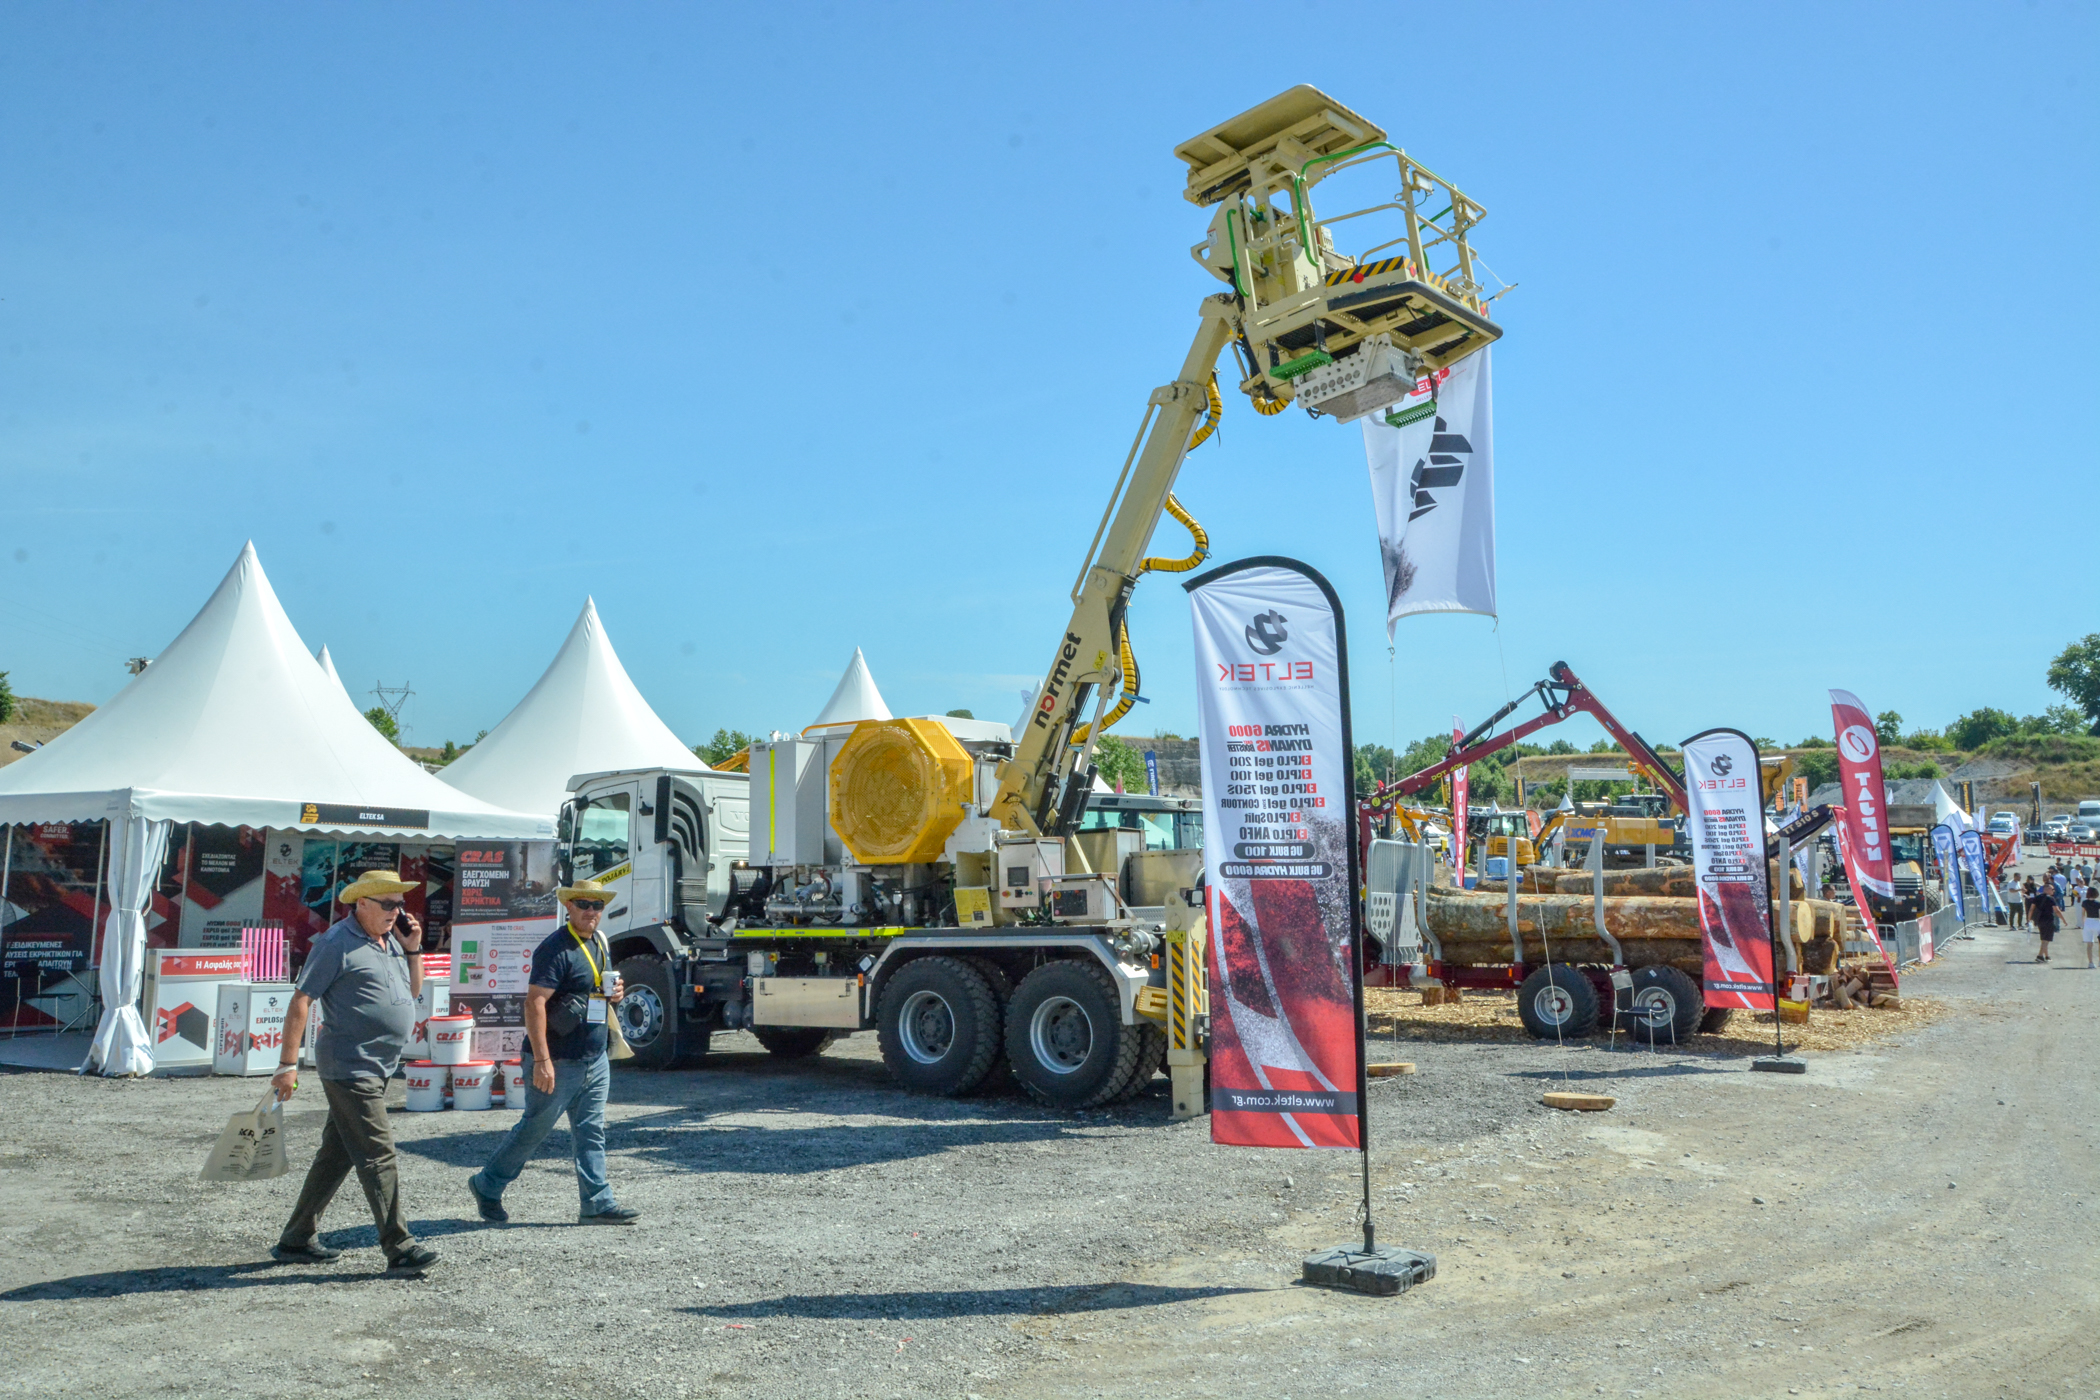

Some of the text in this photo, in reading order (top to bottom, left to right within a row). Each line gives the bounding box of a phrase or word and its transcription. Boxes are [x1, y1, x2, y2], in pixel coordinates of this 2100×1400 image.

[1034, 632, 1082, 729] normet
[1431, 770, 1447, 781] DOT
[1428, 816, 1447, 825] JCB
[1782, 810, 1819, 835] TT 510 S
[43, 826, 69, 834] SAFER.
[460, 850, 505, 863] CRAS
[462, 870, 510, 879] ΕΛΕΓΧΟΜΕΝΗ
[462, 879, 490, 887] ΘΡΑΥΣΗ
[462, 888, 483, 897] ΧΩΡΙΣ
[461, 897, 501, 906] ΕΚΡΗΚΤΙΚΑ
[204, 960, 233, 971] Ασφαλής
[436, 1032, 464, 1041] CRAS
[407, 1078, 431, 1087] CRAS
[455, 1078, 480, 1086] CRAS
